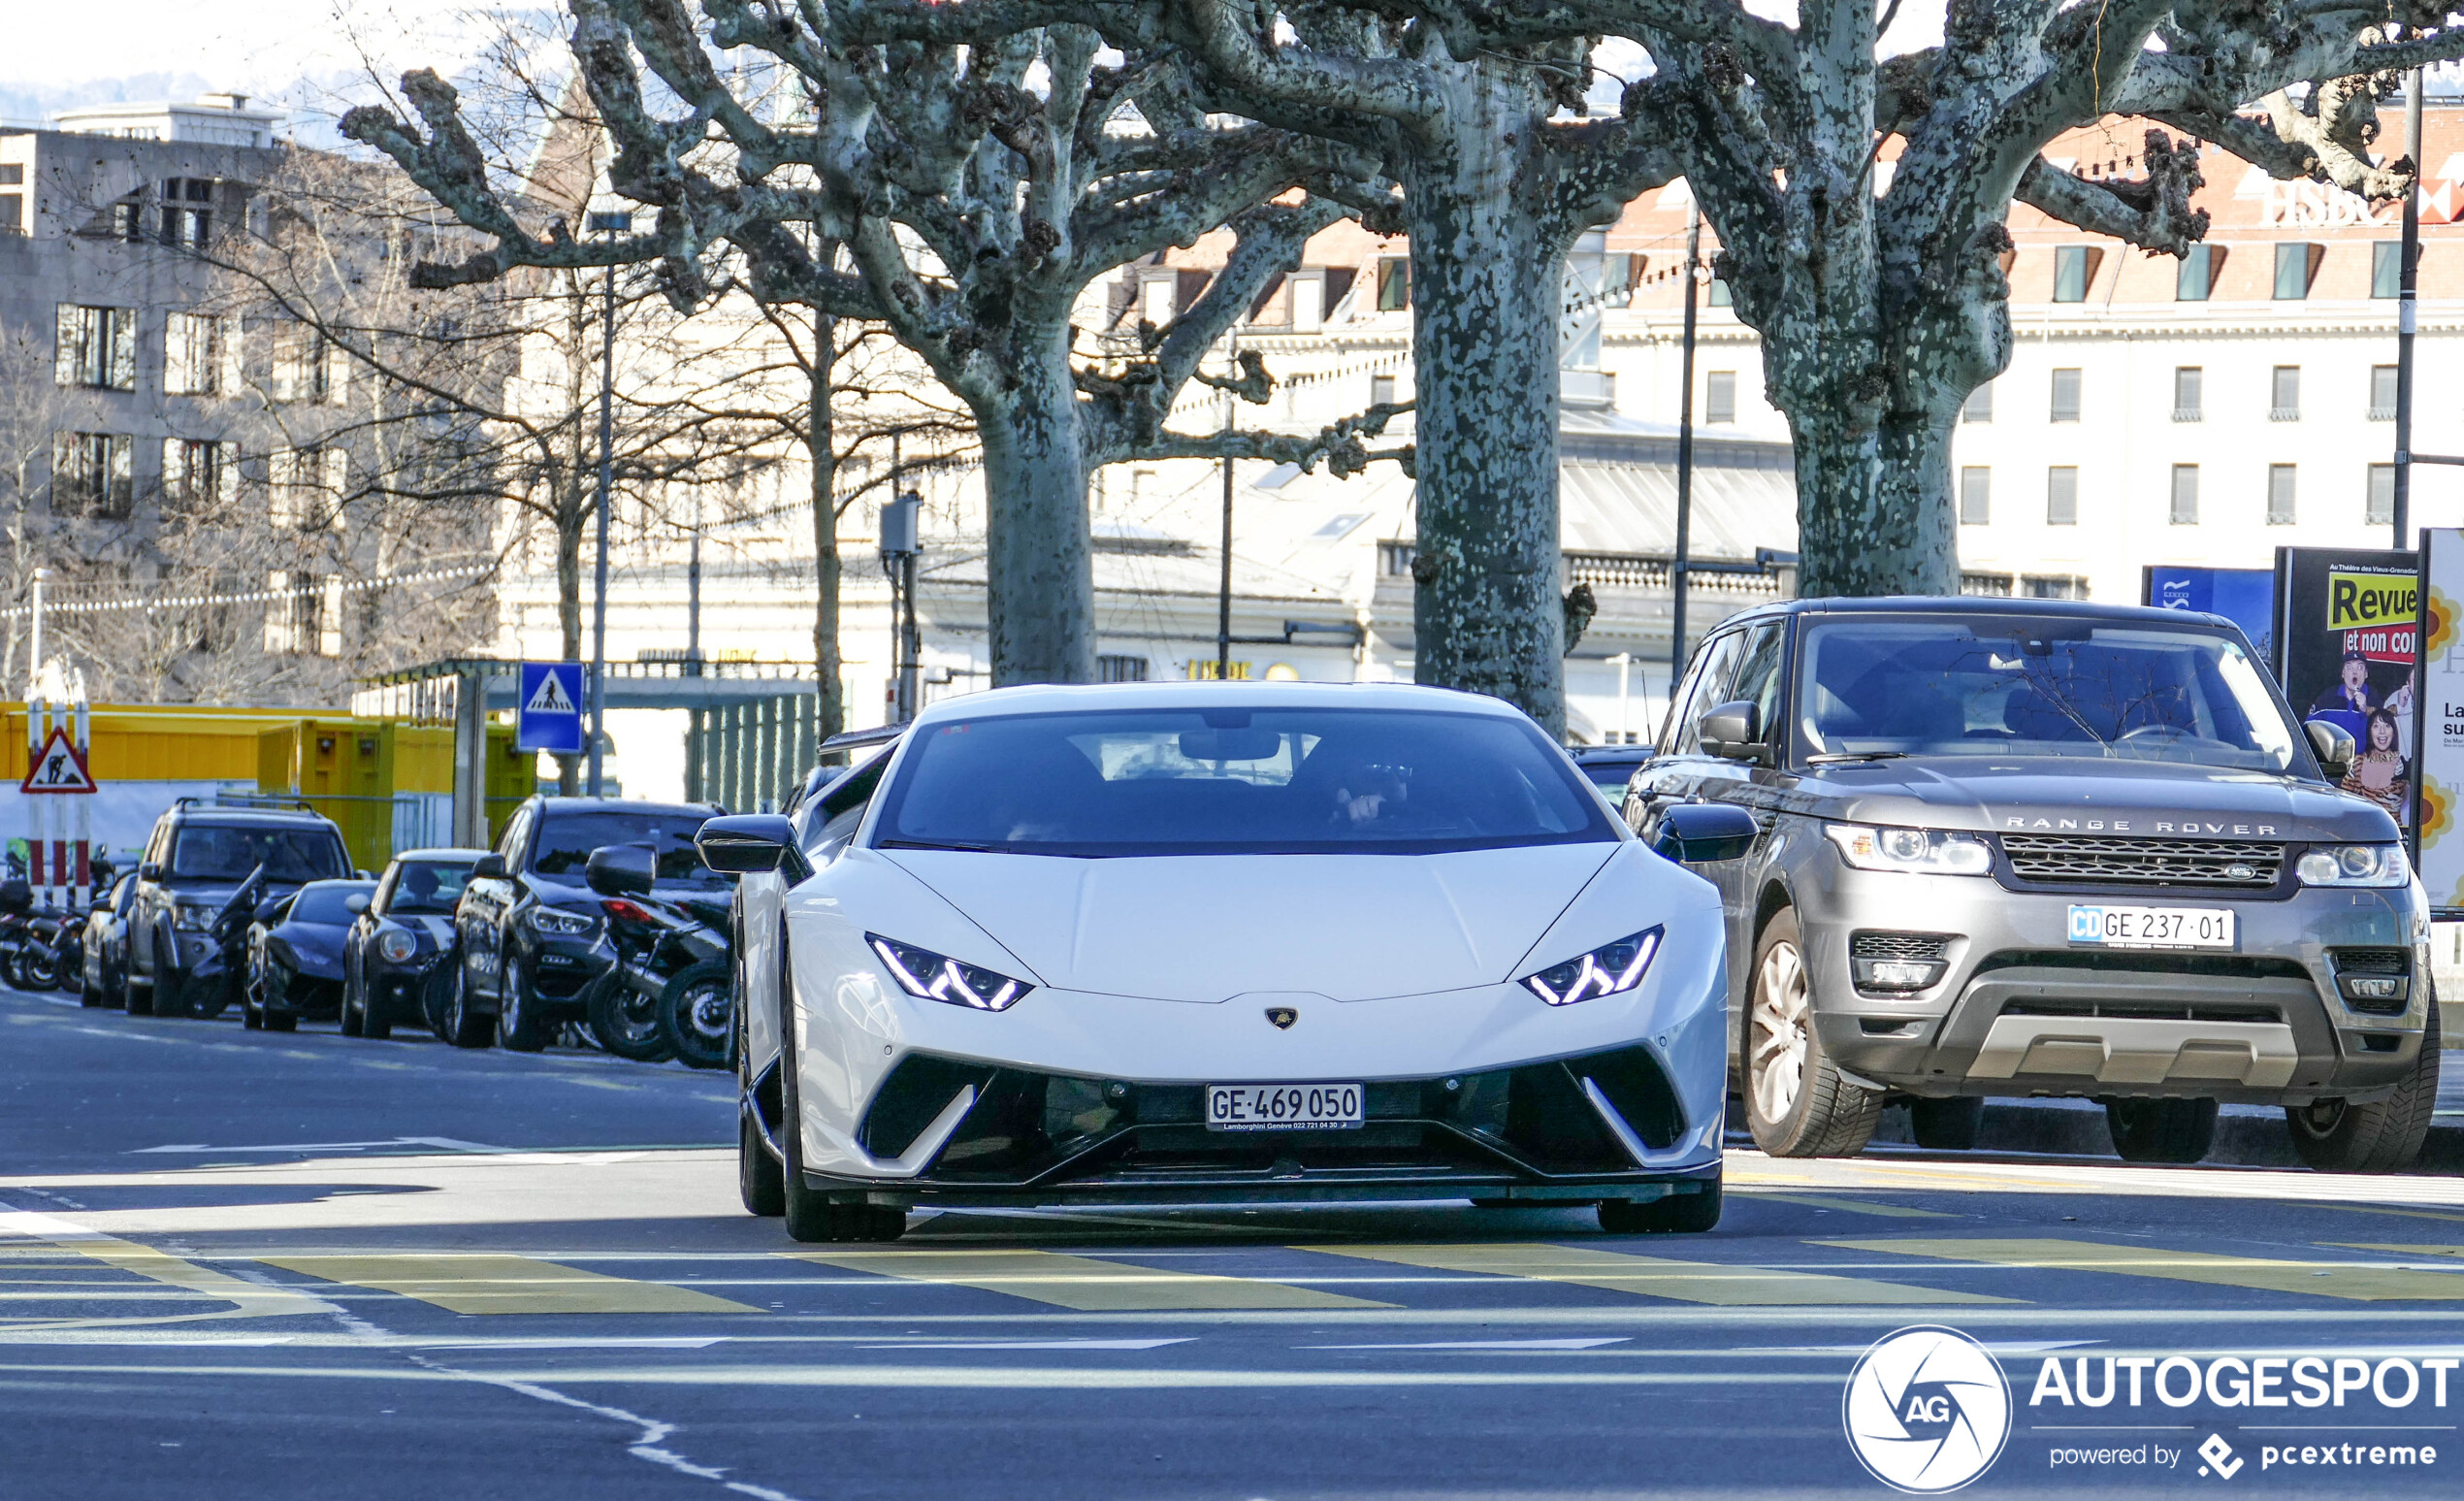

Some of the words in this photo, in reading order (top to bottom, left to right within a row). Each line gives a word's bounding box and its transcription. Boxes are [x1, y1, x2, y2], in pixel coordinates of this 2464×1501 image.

[2333, 579, 2416, 624] Revue
[2348, 630, 2358, 651] et
[2361, 633, 2386, 652] non
[2007, 816, 2130, 831] RANGE
[2156, 822, 2278, 835] ROVER
[2105, 912, 2132, 937] GE
[1309, 1088, 1357, 1118] 050
[1223, 1123, 1266, 1131] Lamborghini
